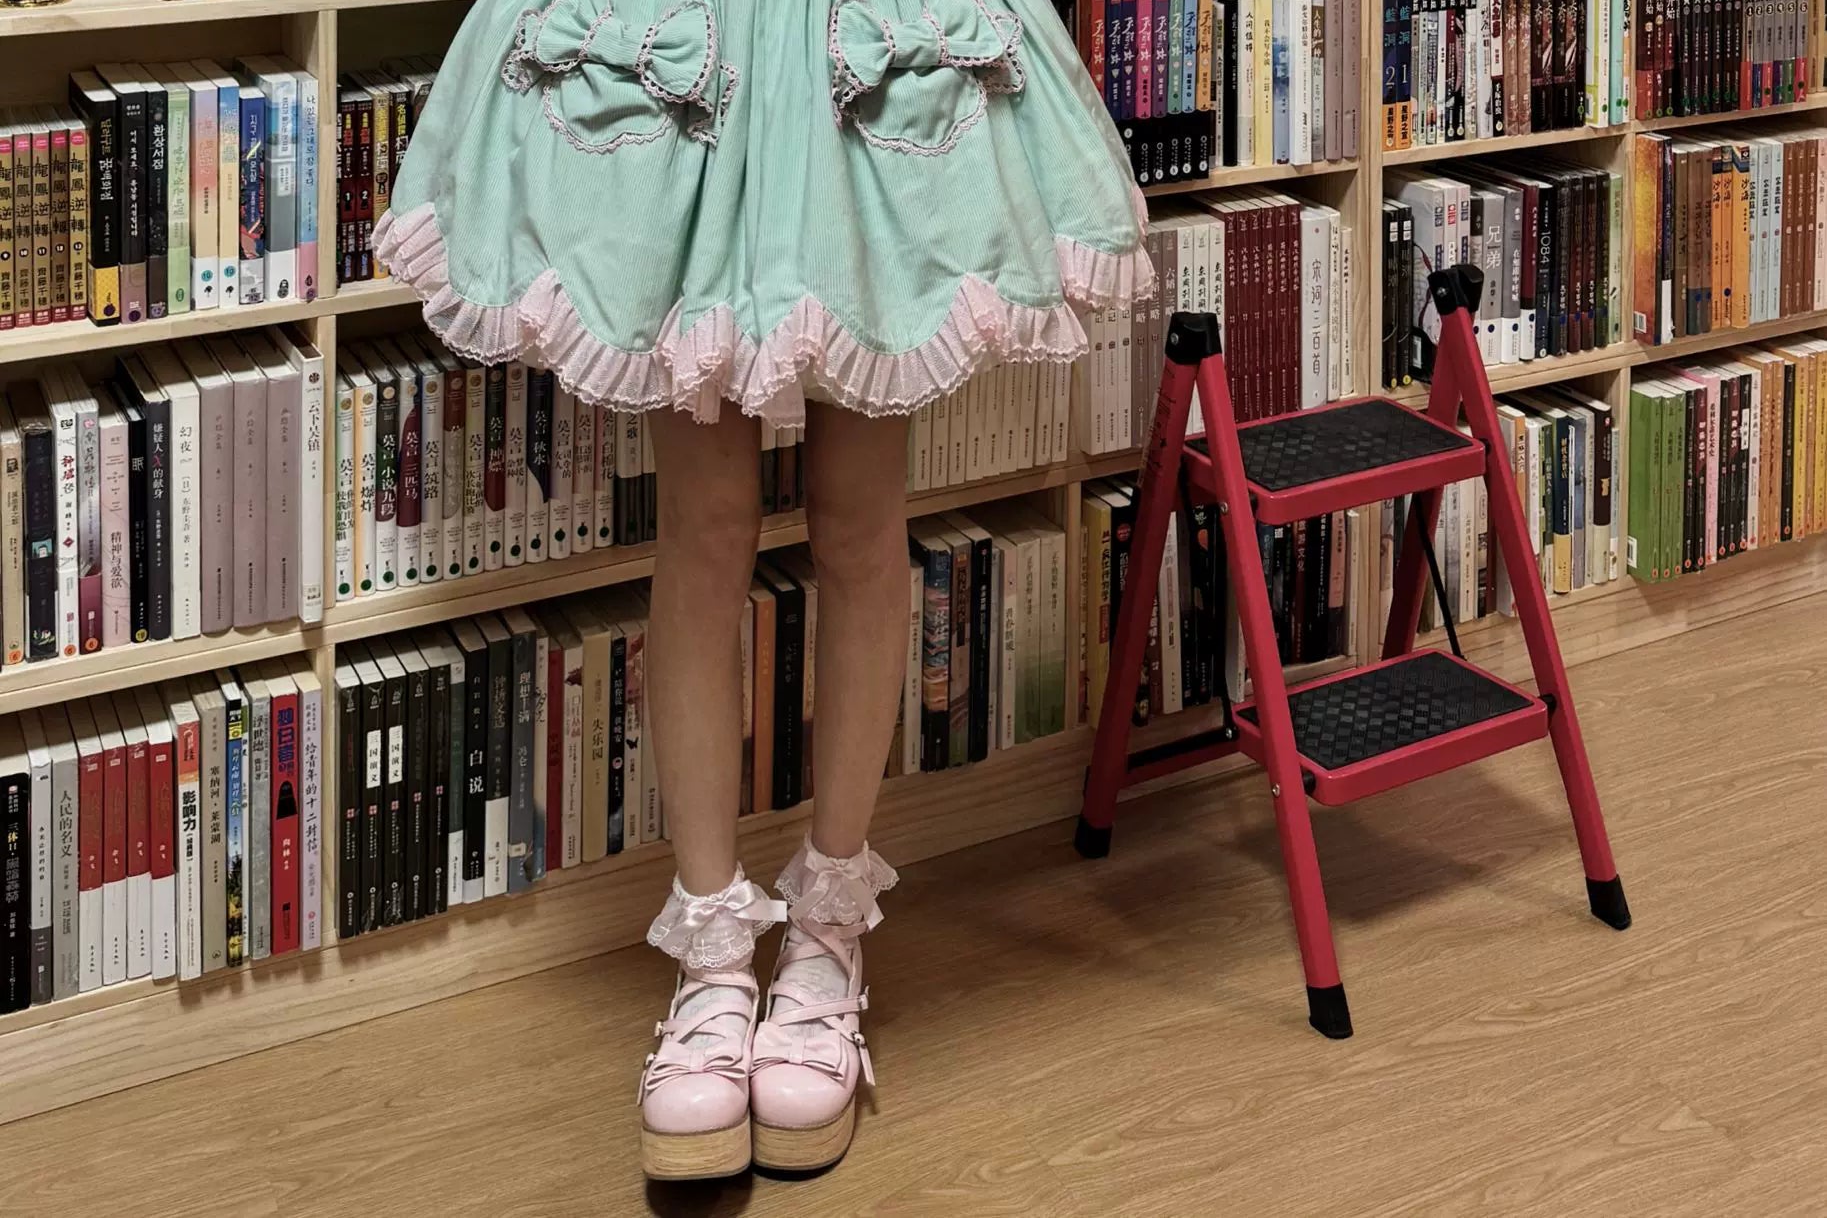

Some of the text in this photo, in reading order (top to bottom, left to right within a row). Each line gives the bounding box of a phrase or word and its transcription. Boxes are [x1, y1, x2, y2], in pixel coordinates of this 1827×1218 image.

[1245, 12, 1253, 53] 人间值得
[1385, 67, 1396, 85] 2
[1402, 65, 1407, 83] 1
[152, 124, 165, 170] 환상서점
[1401, 105, 1409, 140] 星野之宣
[16, 158, 30, 239] 龍鳳逆轉
[34, 156, 49, 238] 龍鳳逆轉
[53, 153, 67, 235] 龍鳳逆轉
[71, 152, 85, 232] 龍鳳逆轉
[1486, 226, 1502, 269] 兄弟
[1312, 259, 1322, 376] 宋词三百首
[152, 424, 164, 499] 嫌疑人X的献身
[180, 427, 192, 453] 幻夜
[533, 412, 546, 464] 莫言 秋水
[132, 458, 143, 471] 眠
[361, 453, 375, 512] 莫言 爆炸
[381, 435, 396, 515] 莫言 小说九段
[405, 432, 418, 499] 莫言 三匹马
[425, 441, 439, 499] 莫言 筑路
[110, 532, 122, 589] 精神与爱欲
[519, 673, 531, 723] 理想丰满
[369, 732, 379, 782] 三国演义
[391, 728, 400, 778] 三国演义
[592, 719, 604, 760] 失乐园
[305, 743, 318, 852] 给青年的十二封信
[469, 750, 484, 794] 白说
[59, 790, 73, 857] 人民的名义
[183, 791, 197, 831] 影响力
